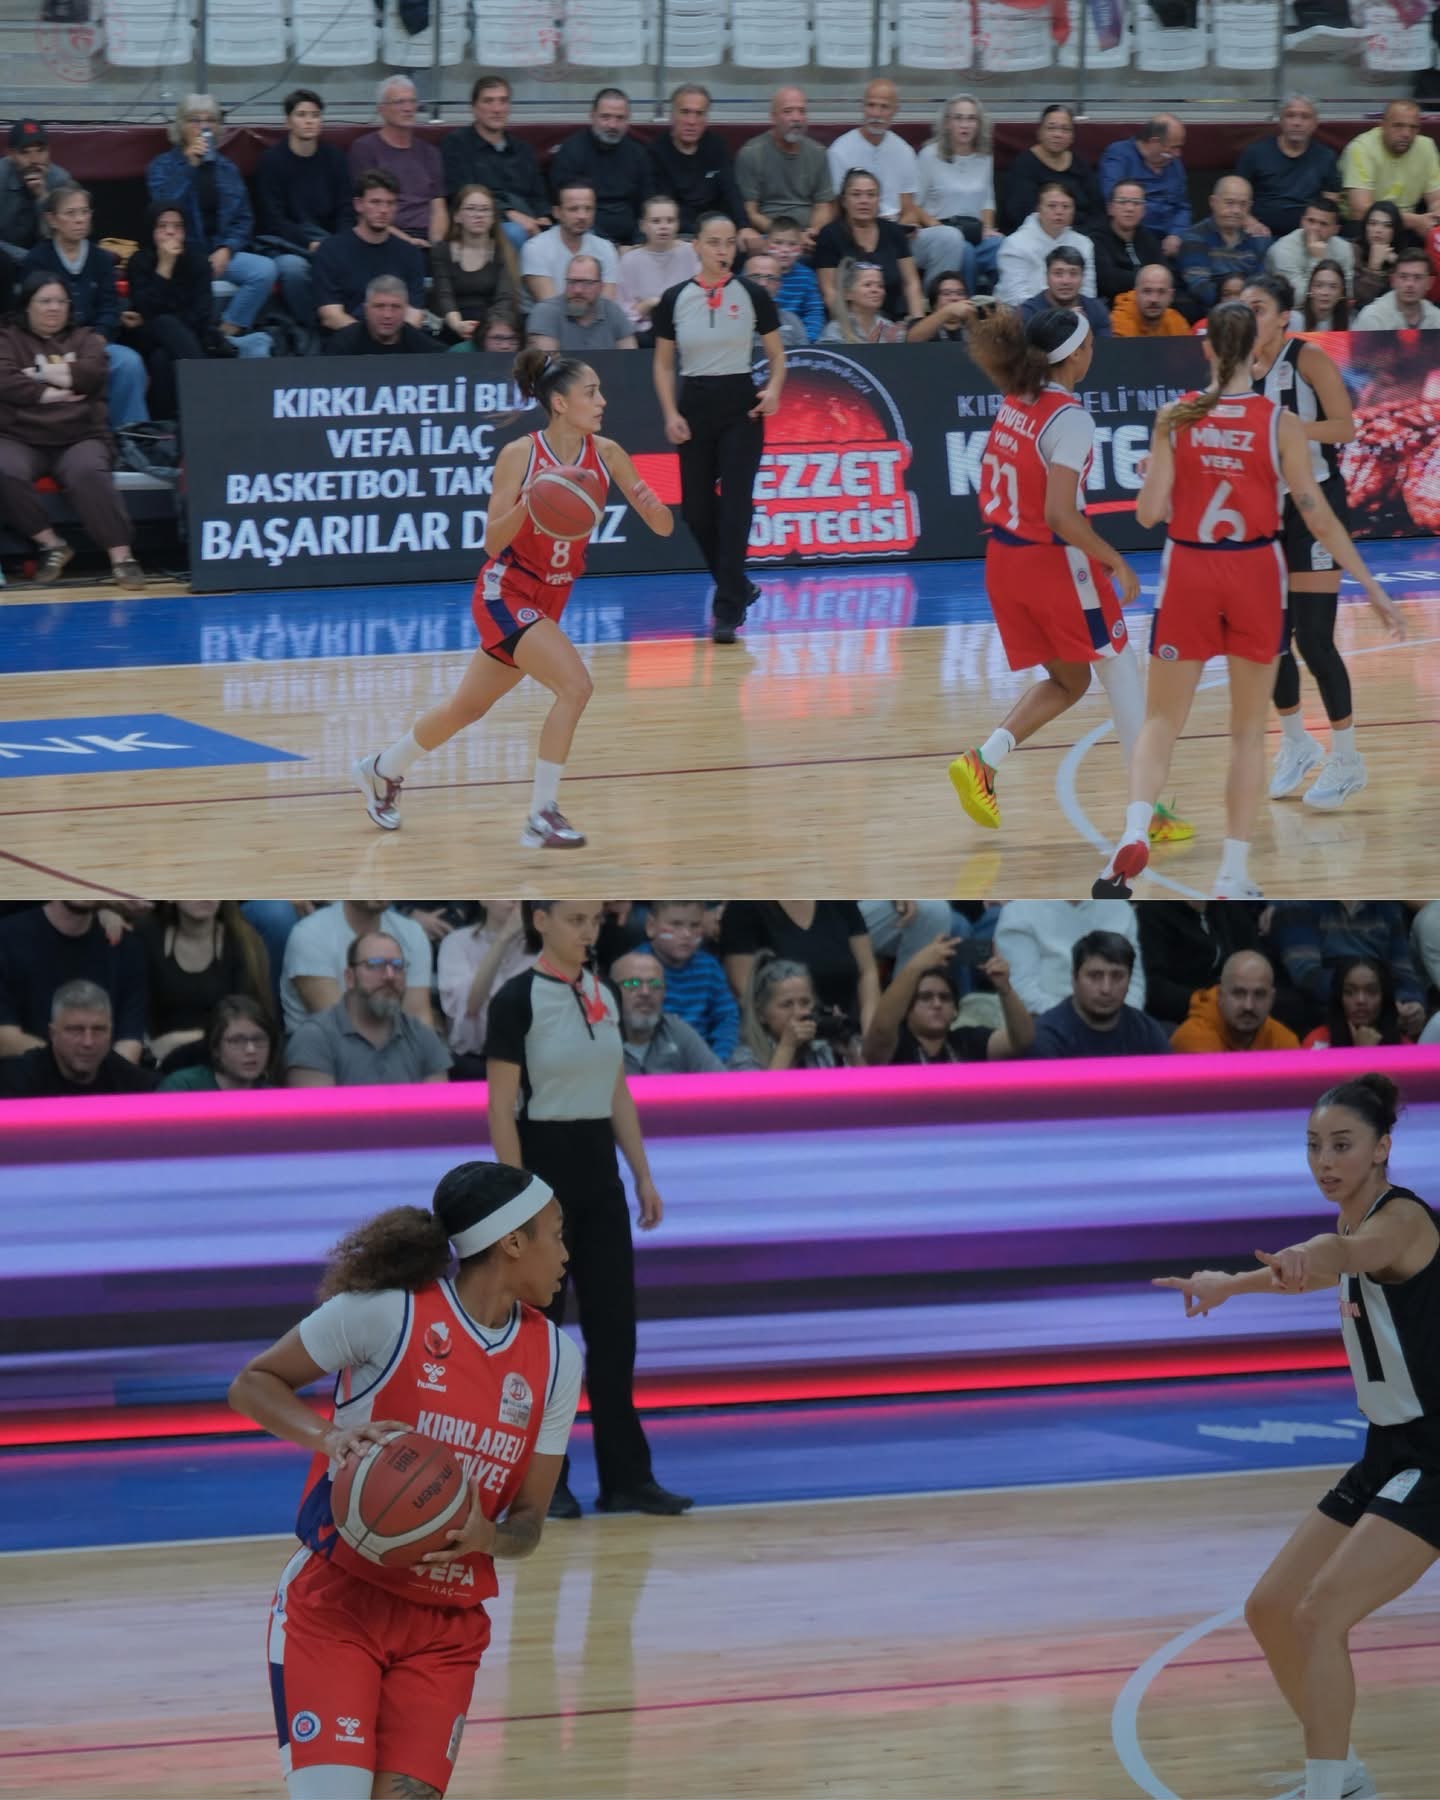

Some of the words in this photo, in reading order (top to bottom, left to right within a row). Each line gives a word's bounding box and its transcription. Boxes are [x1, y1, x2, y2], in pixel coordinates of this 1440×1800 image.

[273, 376, 467, 418] KIRKLARELİ
[326, 427, 415, 459] VEFA
[420, 418, 495, 461] İLAÇ
[752, 451, 902, 500] EZZET
[1200, 454, 1245, 471] VEFA
[227, 468, 427, 505] BASKETBOL
[747, 500, 908, 547] ÖFTECİSİ
[1197, 480, 1246, 544] 6
[201, 511, 451, 567] BAŞARILAR
[550, 541, 571, 568] 8
